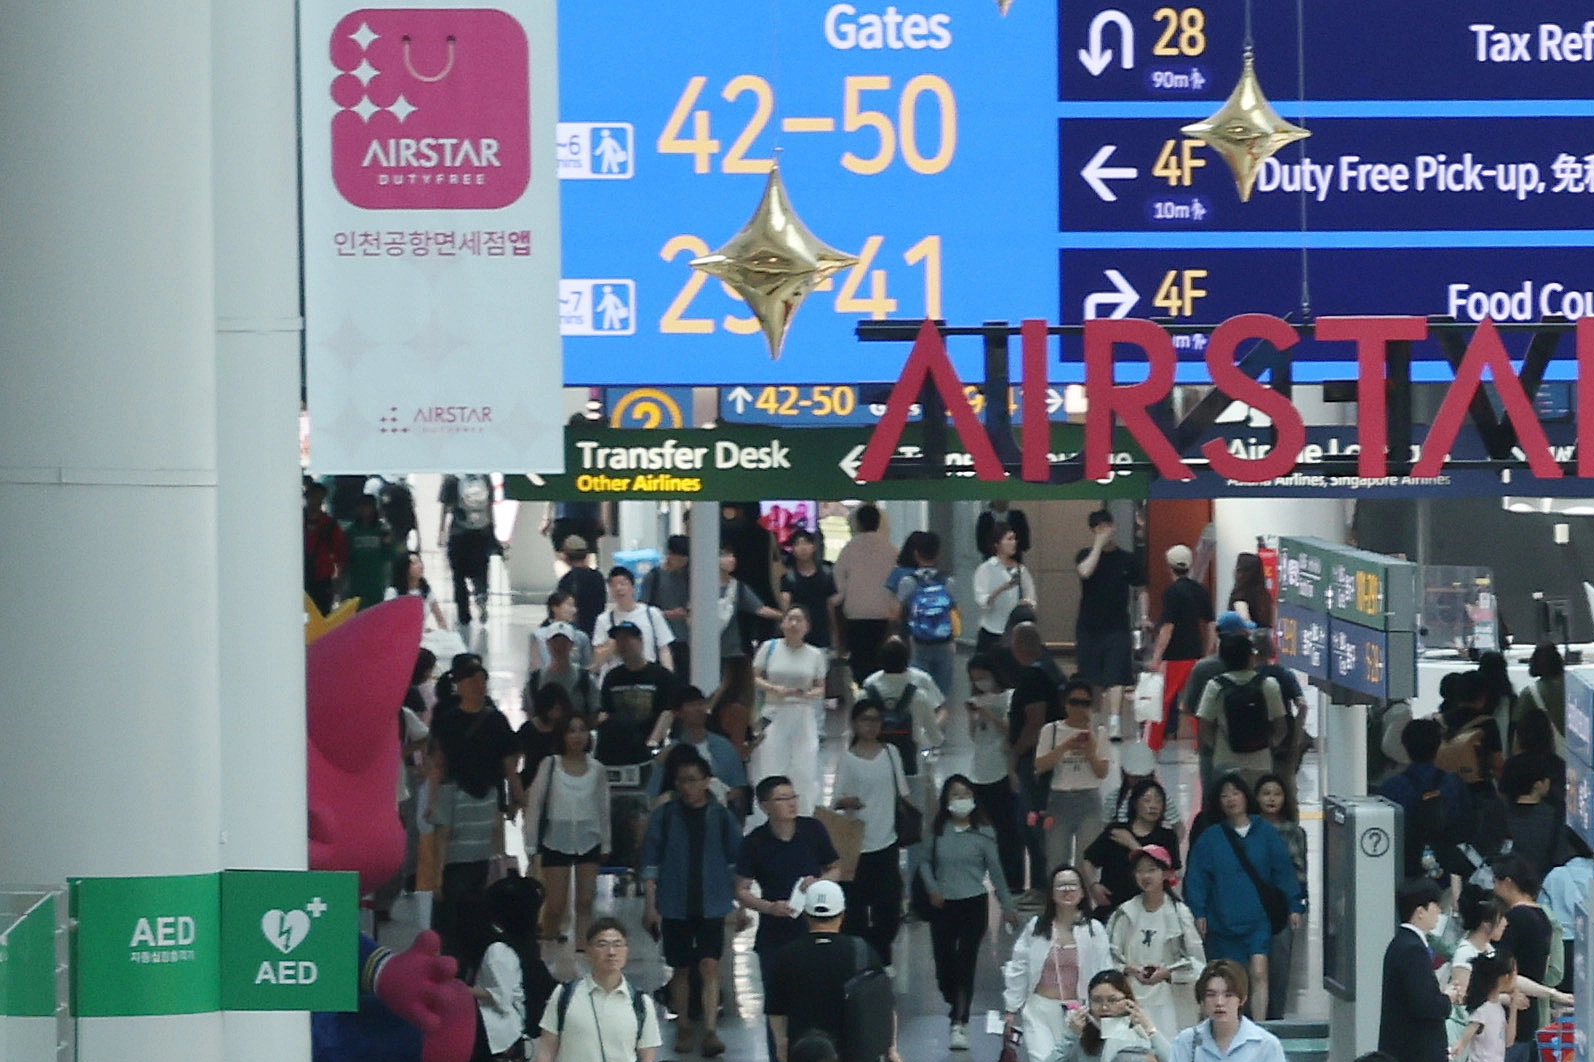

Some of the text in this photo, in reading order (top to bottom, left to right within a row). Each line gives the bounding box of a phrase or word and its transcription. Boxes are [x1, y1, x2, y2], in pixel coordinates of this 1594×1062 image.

[823, 3, 952, 52] Gates
[1152, 6, 1206, 57] 28
[1470, 24, 1532, 62] Tax
[1152, 71, 1189, 89] 90m
[656, 74, 959, 176] 42-50
[361, 138, 501, 169] AIRSTAR
[1152, 139, 1207, 186] 4F
[1257, 154, 1335, 202] Duty
[1339, 155, 1409, 192] Free
[1416, 153, 1546, 201] Pick-up,
[1153, 201, 1190, 220] 10m
[333, 230, 532, 258] 인천공항면세점앱
[1152, 269, 1208, 317] 4F
[1447, 281, 1533, 321] Food
[413, 406, 492, 423] AIRSTAR
[754, 386, 855, 417] 42-50
[576, 438, 792, 471] Transfer Desk
[575, 474, 701, 492] Other Airlines
[1275, 472, 1329, 489] Airlines,
[1330, 474, 1398, 490] Singapore
[129, 916, 196, 948] AED
[254, 960, 319, 985] AED
